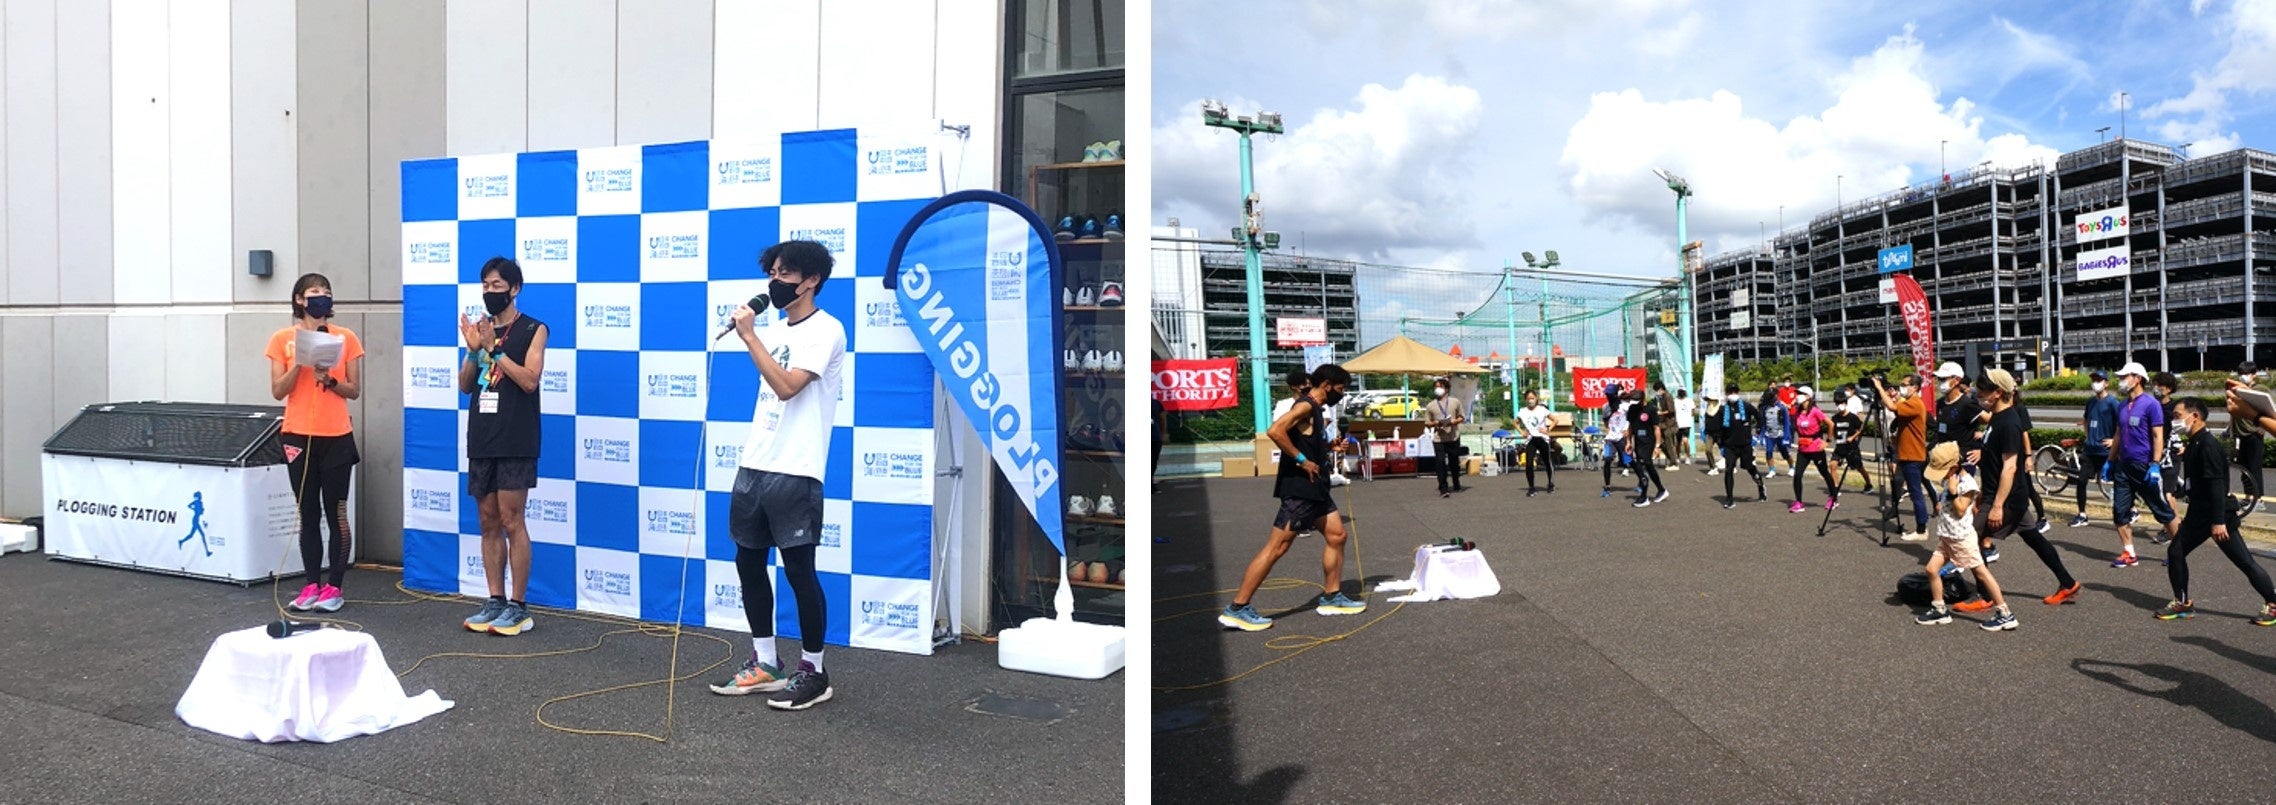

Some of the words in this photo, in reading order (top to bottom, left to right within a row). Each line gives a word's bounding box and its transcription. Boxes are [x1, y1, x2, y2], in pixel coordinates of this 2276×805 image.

[894, 146, 927, 156] CHANGE
[2042, 340, 2049, 352] P
[1151, 368, 1232, 389] ORTS
[890, 453, 922, 461] CHANGE
[57, 499, 117, 517] PLOGGING
[122, 506, 177, 524] STATION
[888, 602, 919, 611] CHANGE
